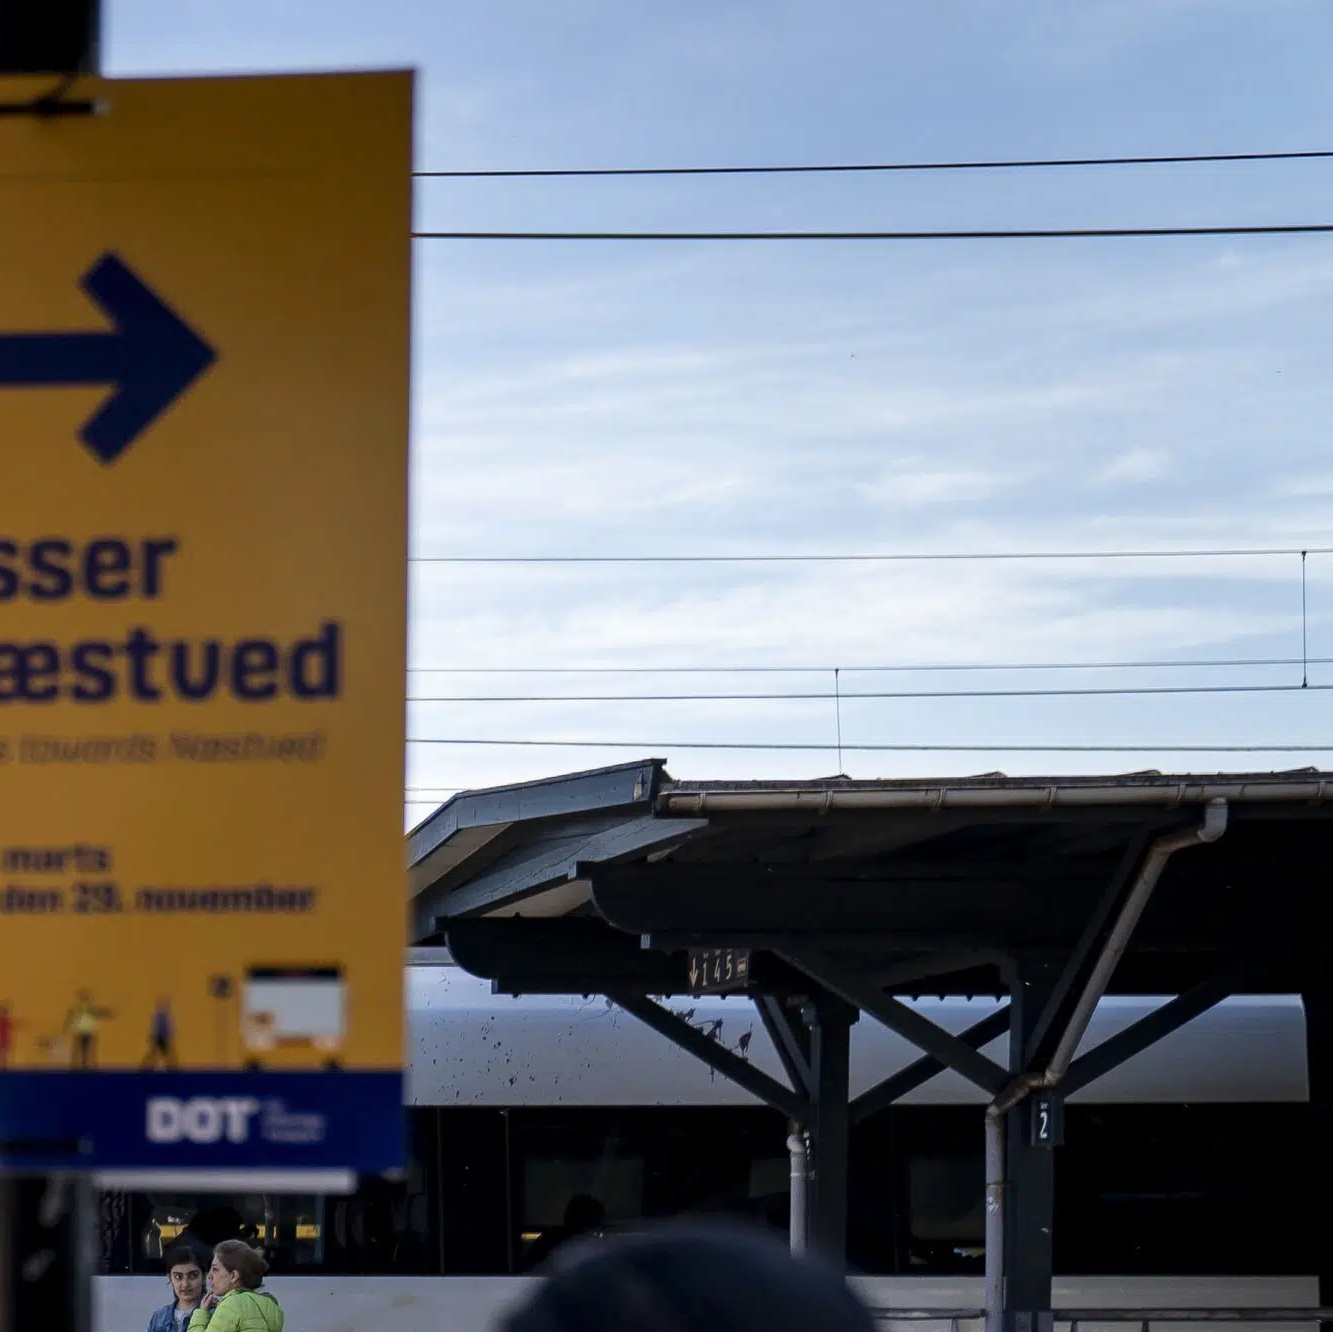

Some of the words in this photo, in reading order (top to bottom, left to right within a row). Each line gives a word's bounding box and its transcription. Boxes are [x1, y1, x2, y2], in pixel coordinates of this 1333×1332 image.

[2, 844, 110, 873] marts
[136, 884, 317, 914] november
[702, 961, 708, 986] 1
[714, 958, 721, 983] 4
[726, 954, 732, 980] 5
[145, 1096, 259, 1144] DOT
[1040, 1111, 1048, 1138] 2
